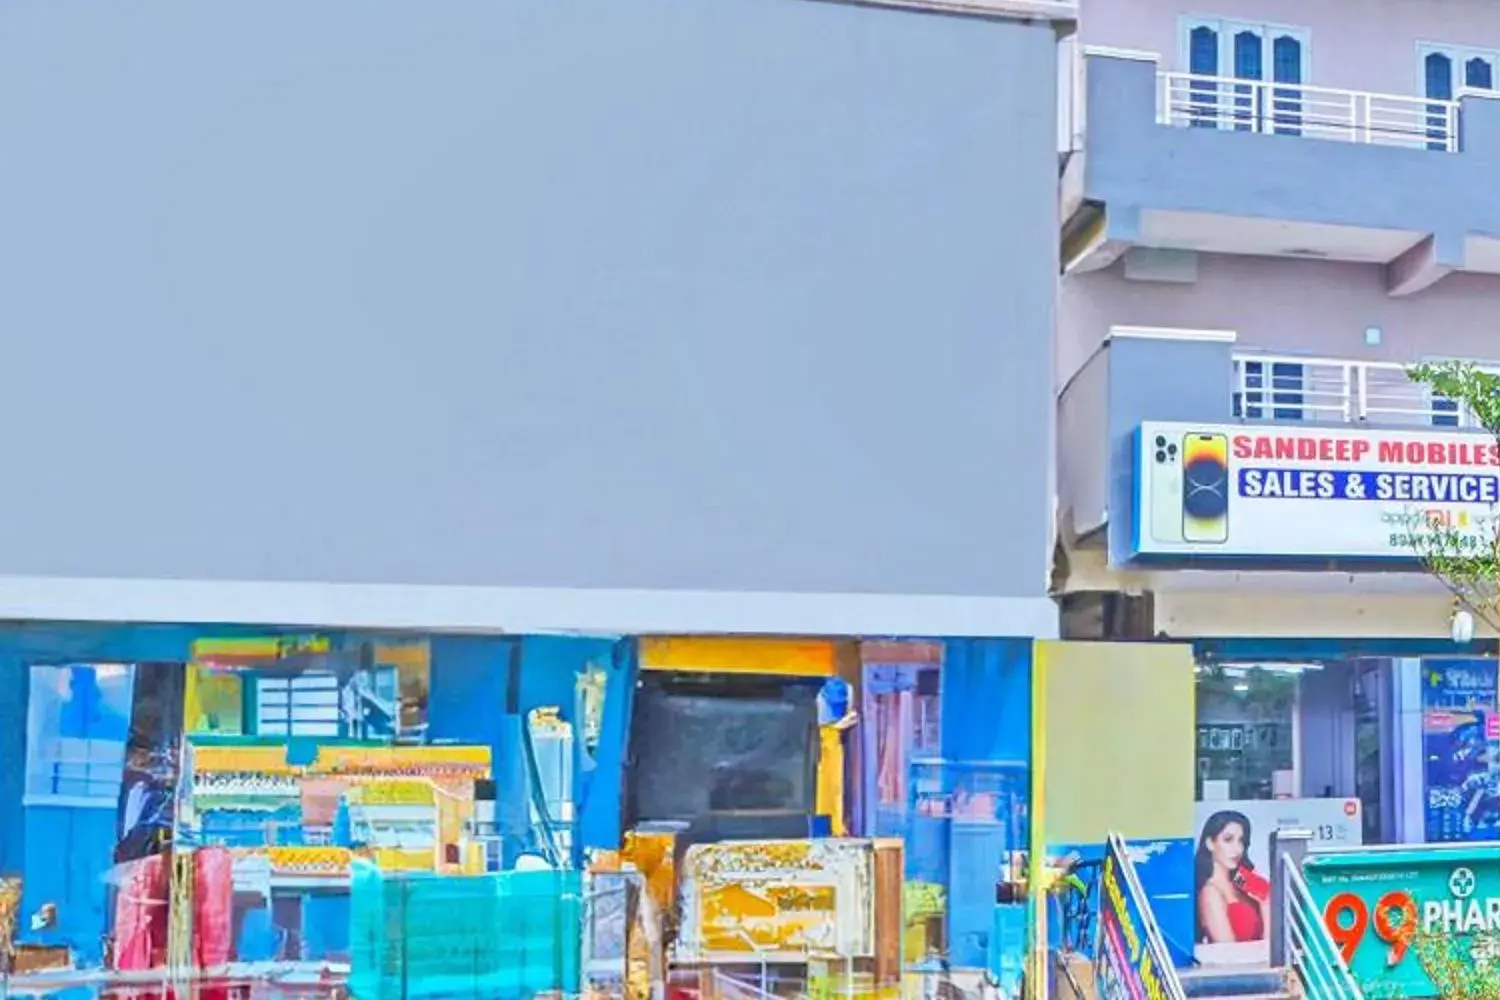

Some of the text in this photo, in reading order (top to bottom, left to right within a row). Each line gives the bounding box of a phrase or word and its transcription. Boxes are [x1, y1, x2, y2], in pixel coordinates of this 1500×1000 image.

[1233, 435, 1369, 463] SANDEEP
[1244, 470, 1495, 502] SALES & SERVICE
[1322, 891, 1418, 966] 99
